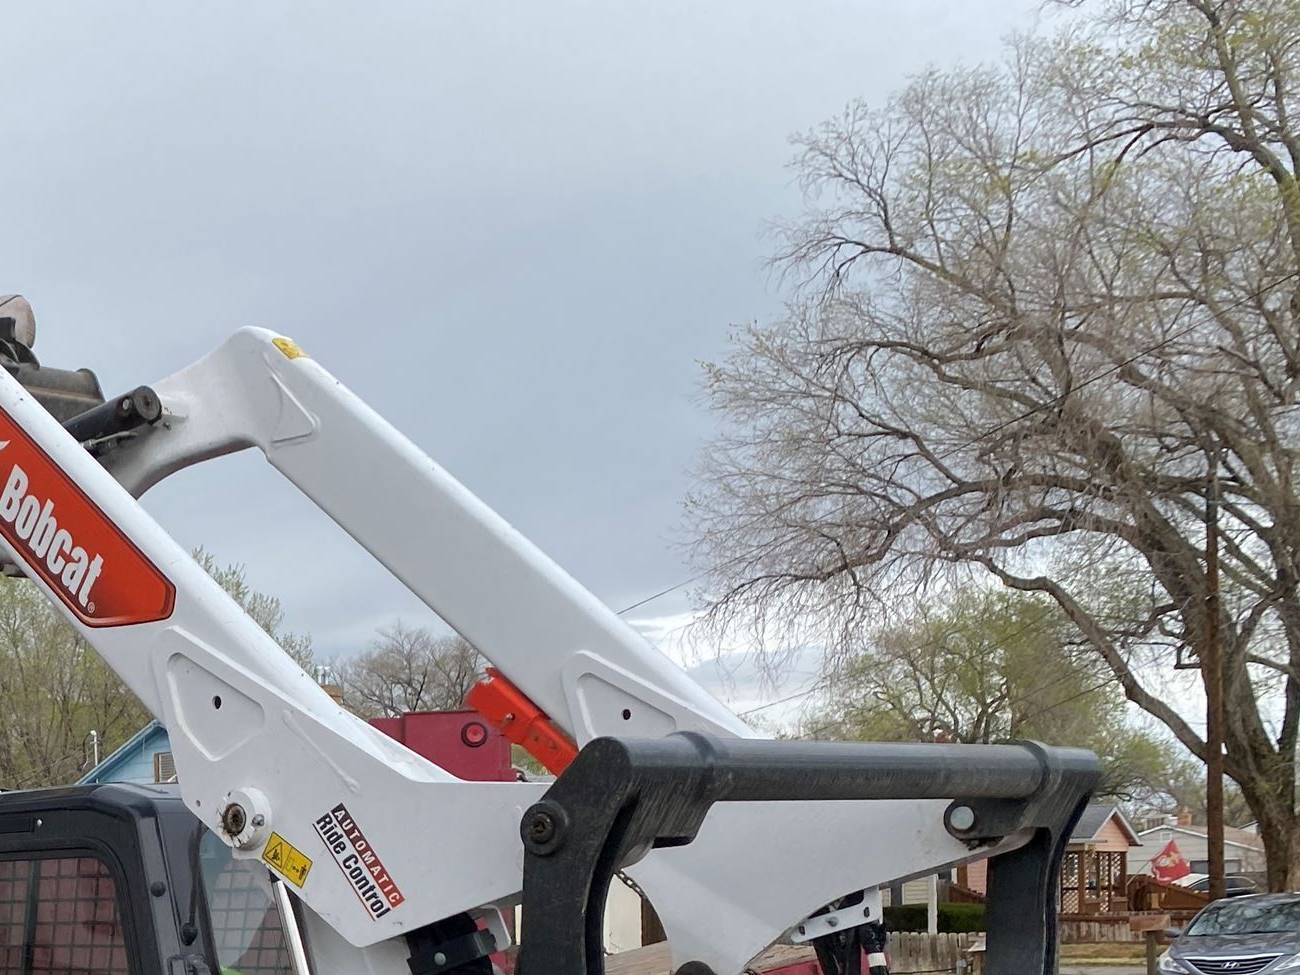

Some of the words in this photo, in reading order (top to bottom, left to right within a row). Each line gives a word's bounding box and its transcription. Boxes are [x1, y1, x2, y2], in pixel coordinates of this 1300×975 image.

[316, 812, 347, 855] Ride
[342, 853, 391, 919] Control
[334, 809, 400, 903] AUTOMATIC
